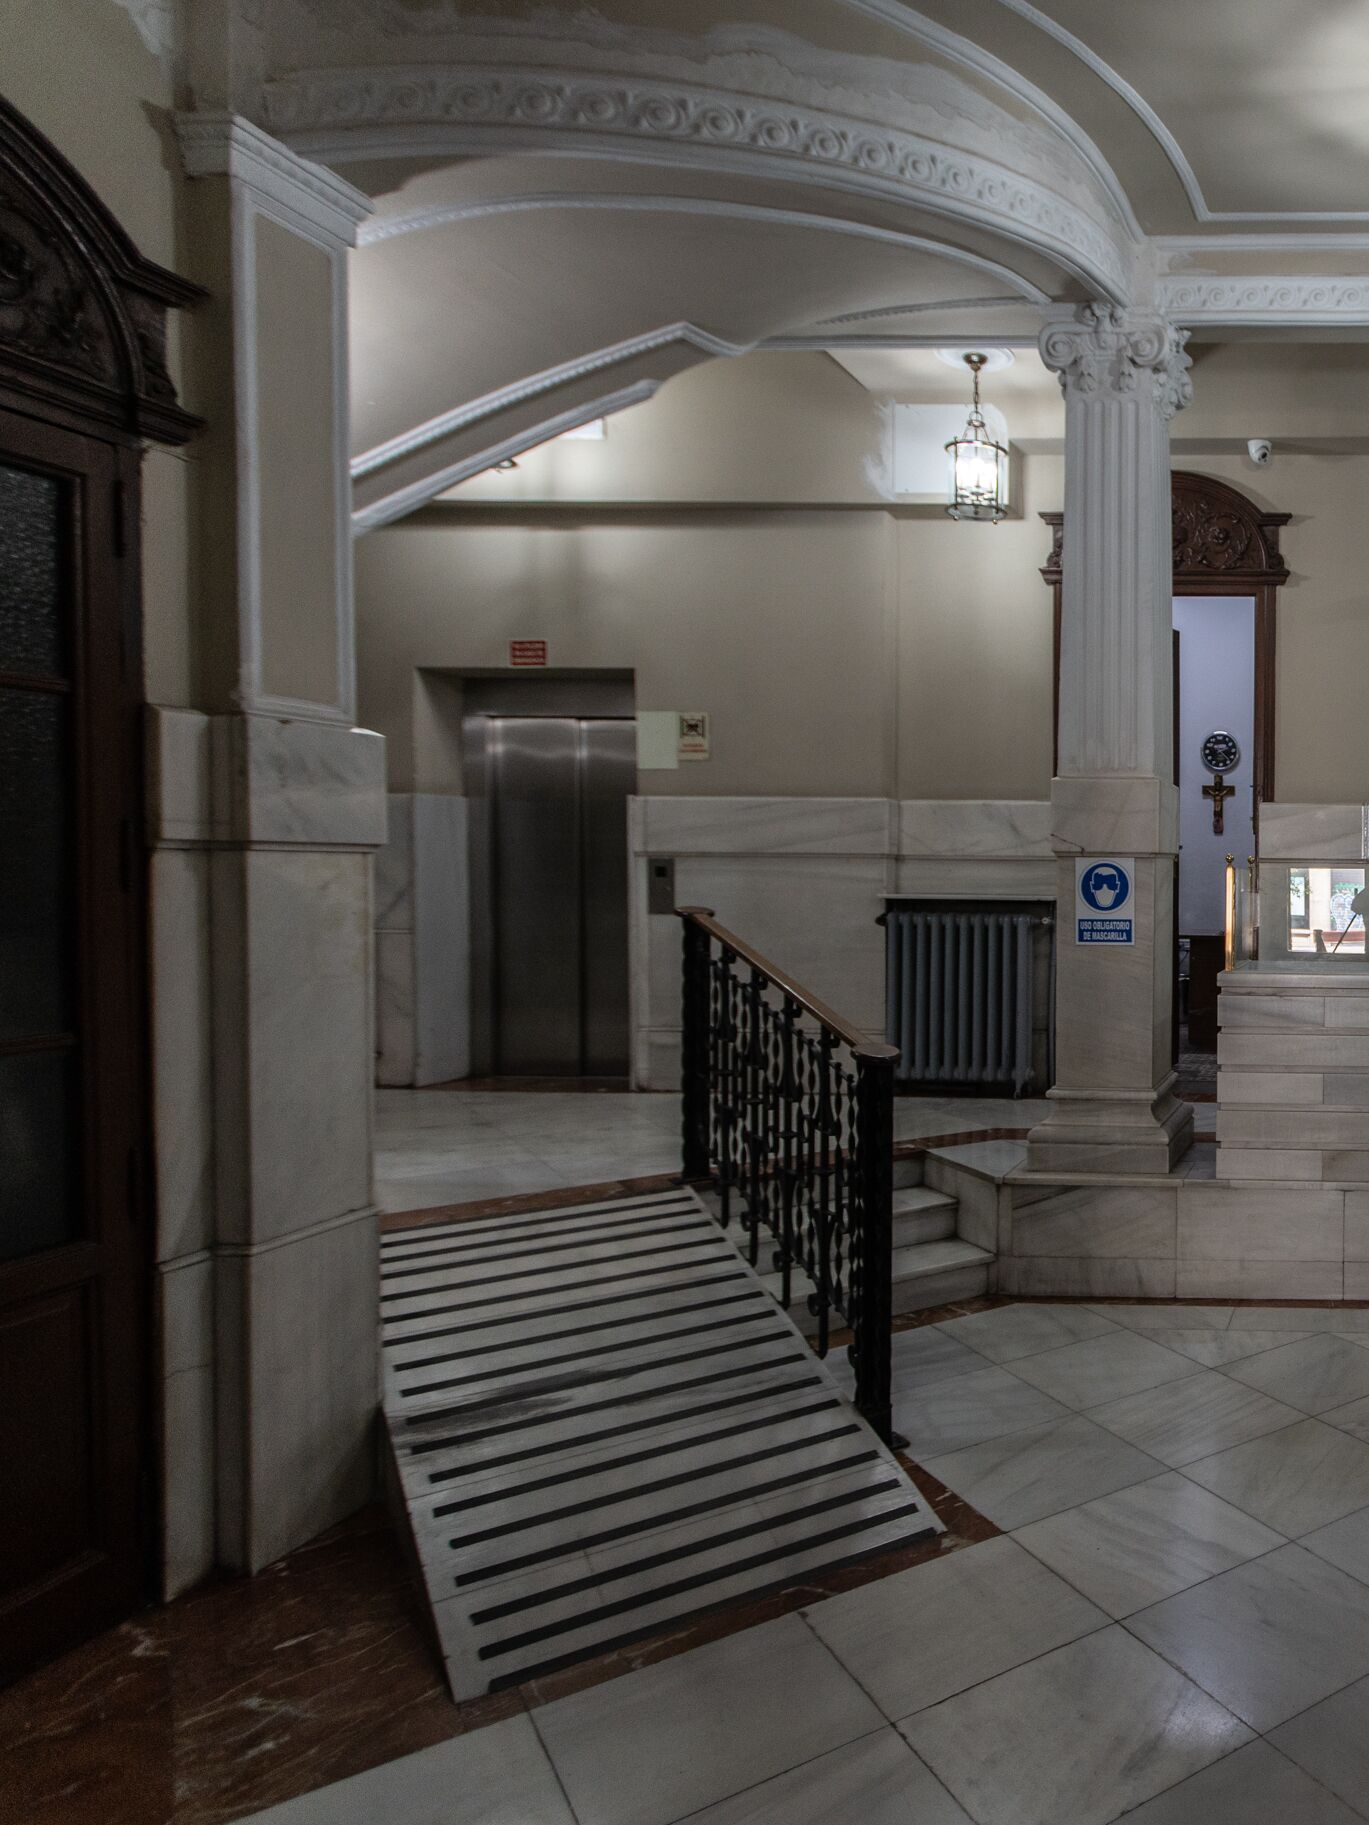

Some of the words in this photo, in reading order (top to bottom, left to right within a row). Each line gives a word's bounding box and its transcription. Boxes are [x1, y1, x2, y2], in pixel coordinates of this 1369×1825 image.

[1080, 921, 1092, 930] USO
[1093, 921, 1130, 930] OBLIGATORIO
[1084, 932, 1090, 940] DE
[1092, 932, 1127, 940] MASCARILLA
